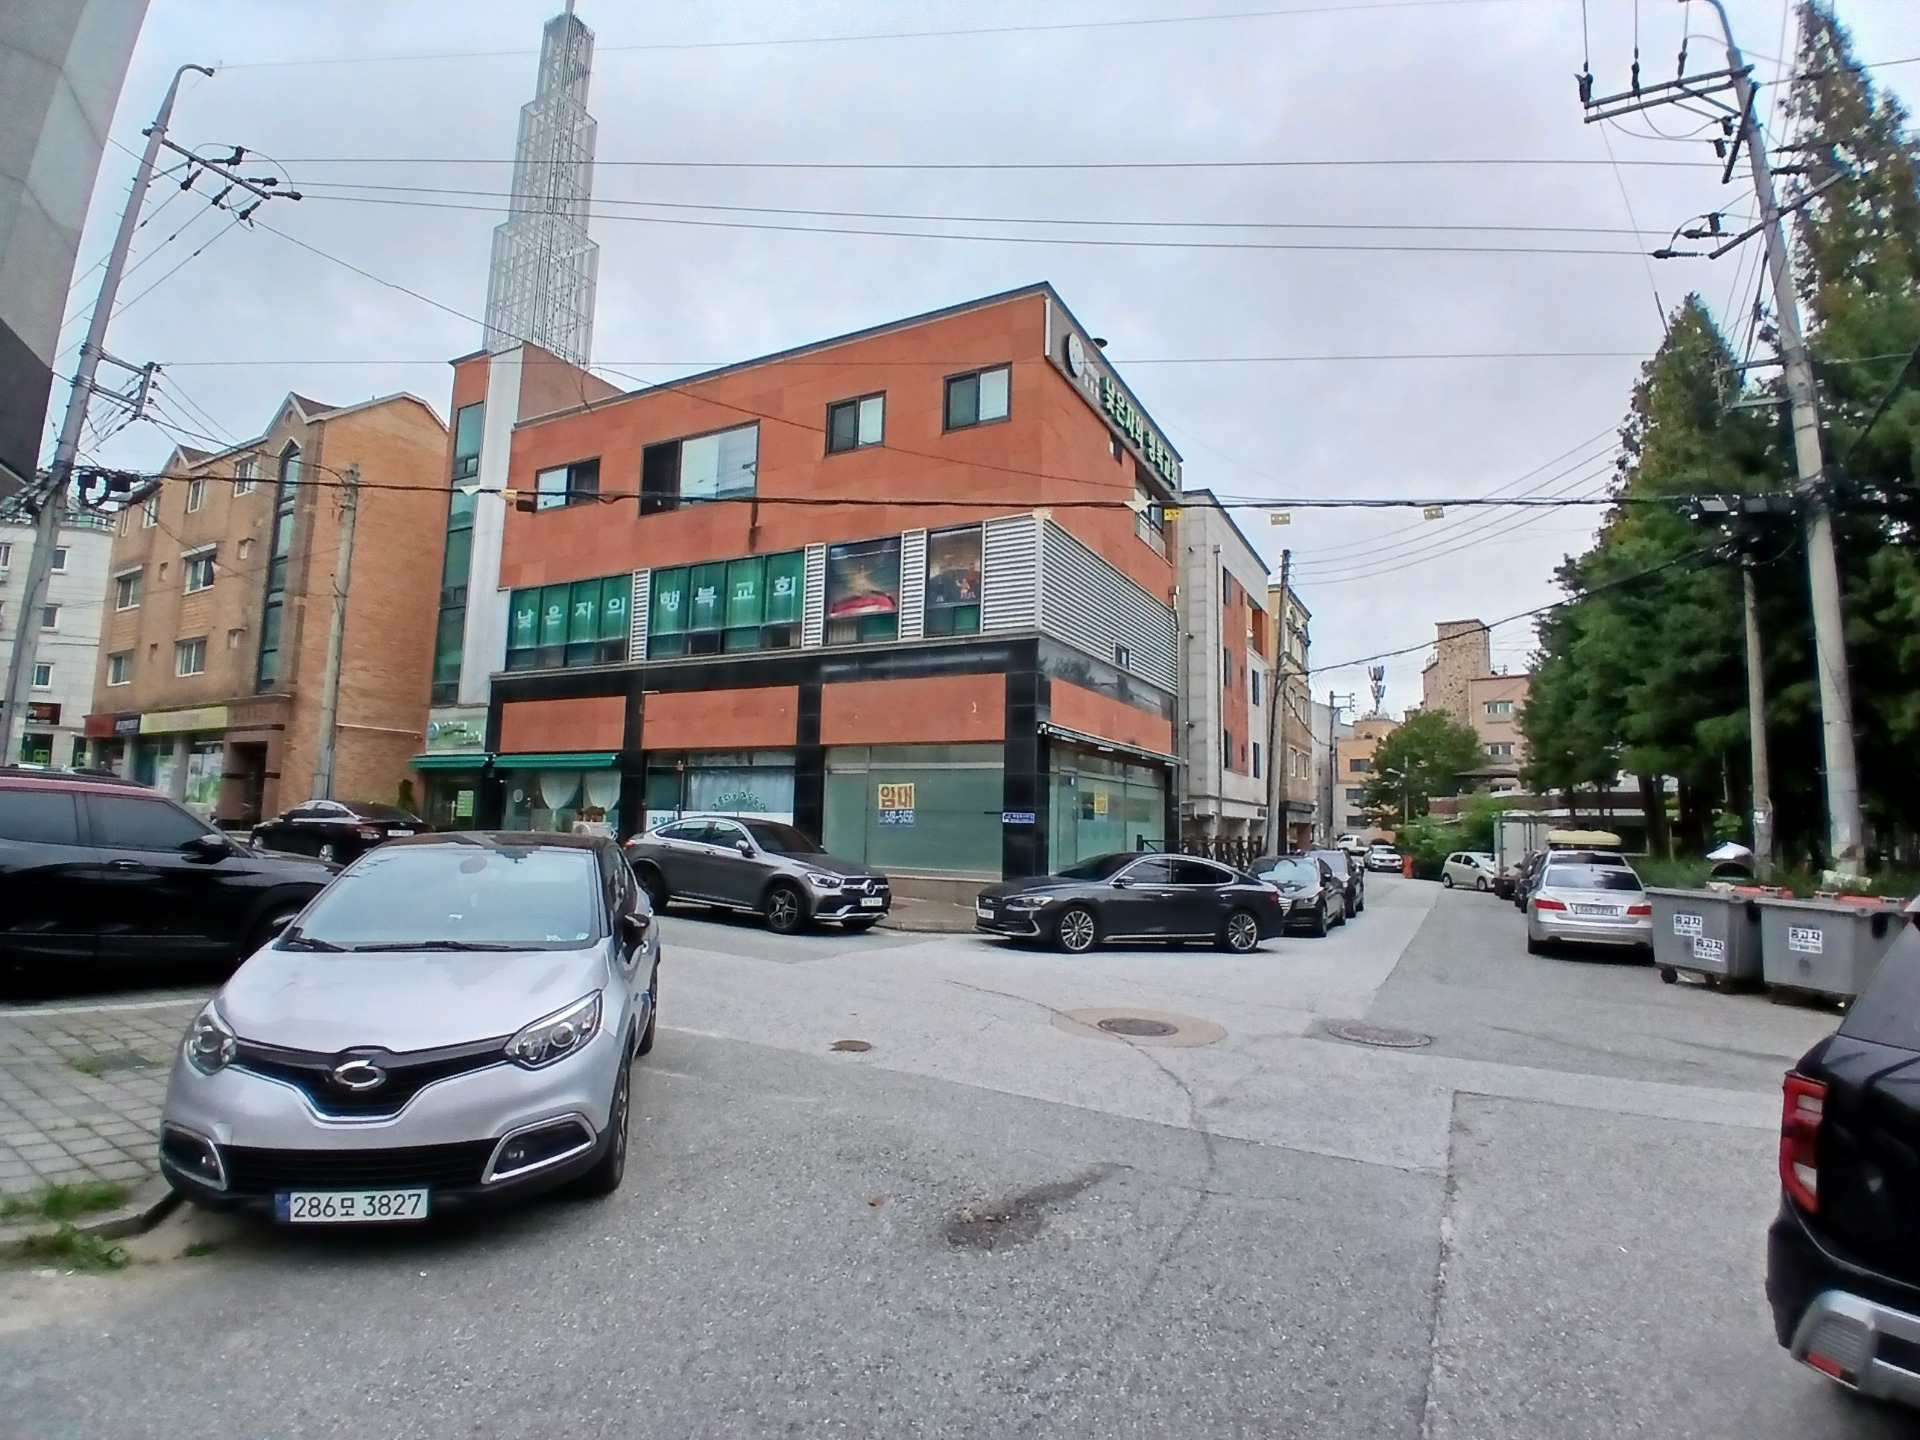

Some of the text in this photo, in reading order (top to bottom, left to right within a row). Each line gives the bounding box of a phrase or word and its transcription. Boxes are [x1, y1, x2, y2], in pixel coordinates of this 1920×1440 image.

[1103, 376, 1178, 488] 낮은자의 행복교회
[516, 575, 797, 629] 낮은자의 행복교회
[880, 785, 913, 809] 임대
[1675, 915, 1701, 926] 중고차
[1695, 938, 1723, 950] 중고차
[1790, 929, 1820, 941] 중고차
[293, 1193, 423, 1219] 286모 3827
